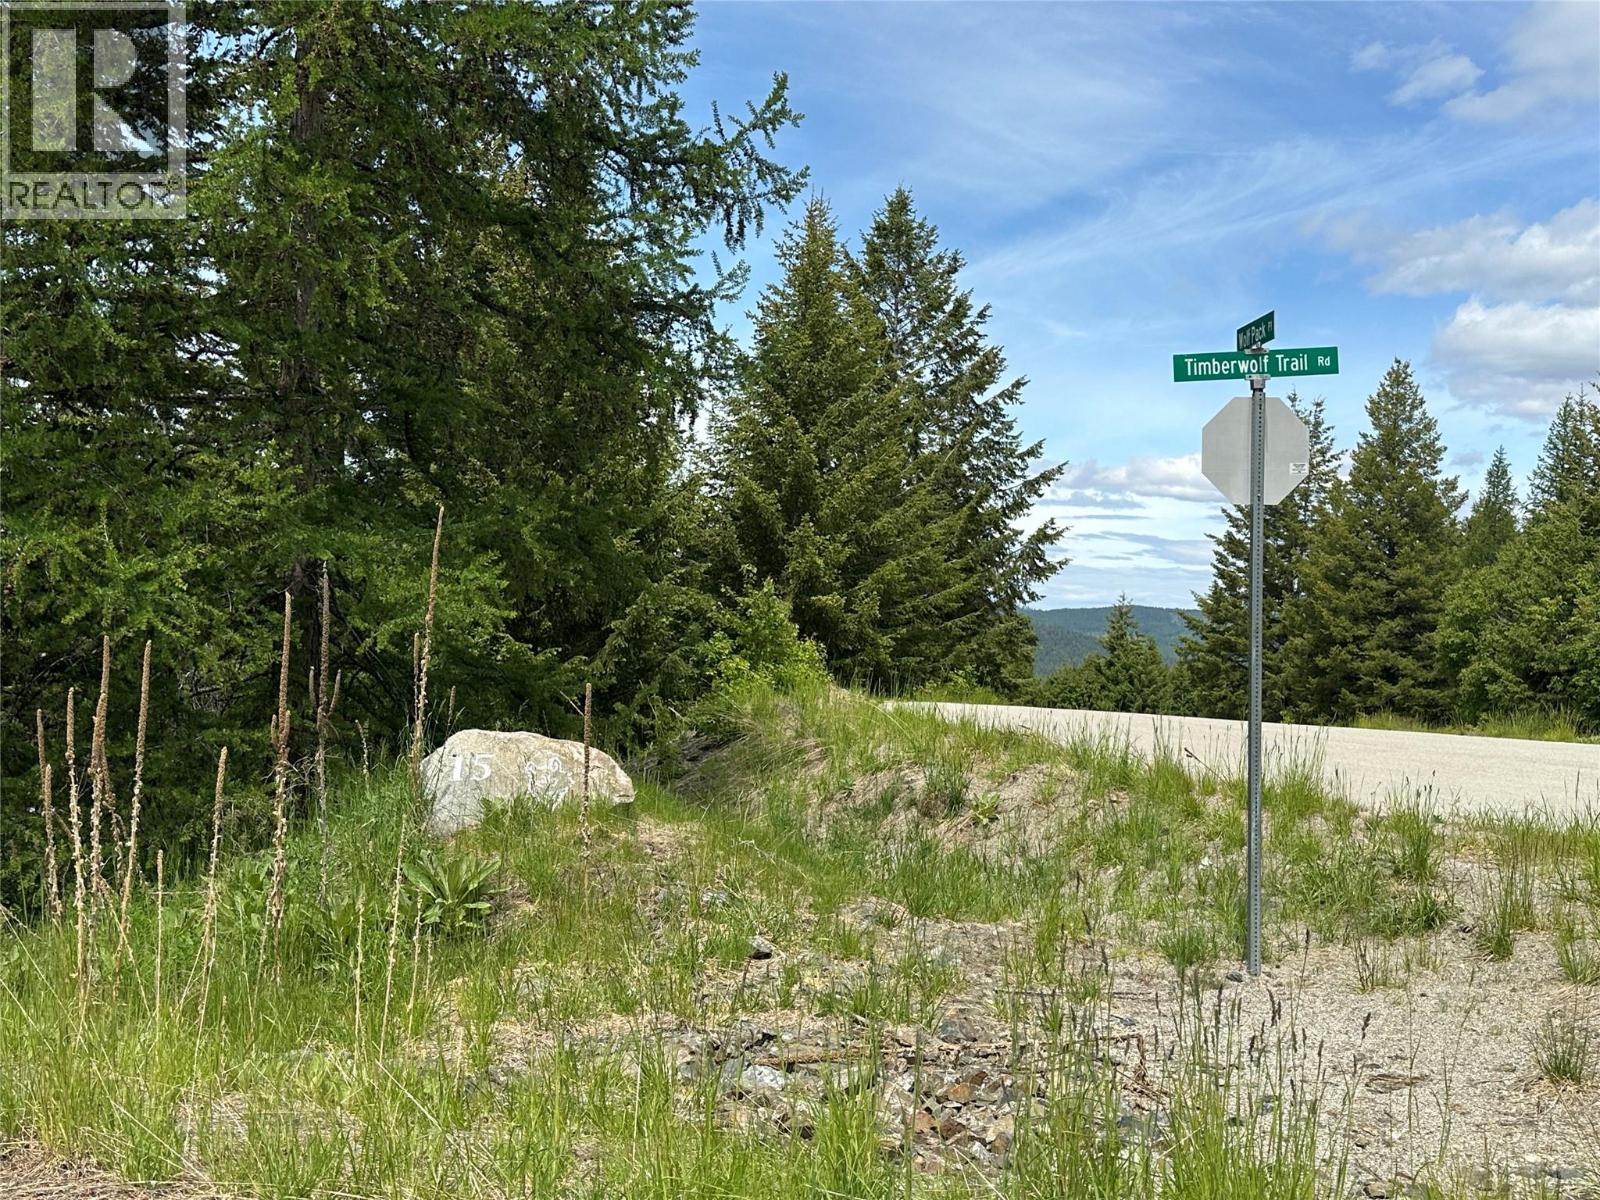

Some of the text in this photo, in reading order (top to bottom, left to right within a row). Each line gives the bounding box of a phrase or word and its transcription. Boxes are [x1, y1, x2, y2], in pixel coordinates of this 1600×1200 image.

[1251, 322, 1266, 344] Pack
[1184, 354, 1331, 376] Timberwolf Trail Rd
[451, 753, 493, 782] 15
